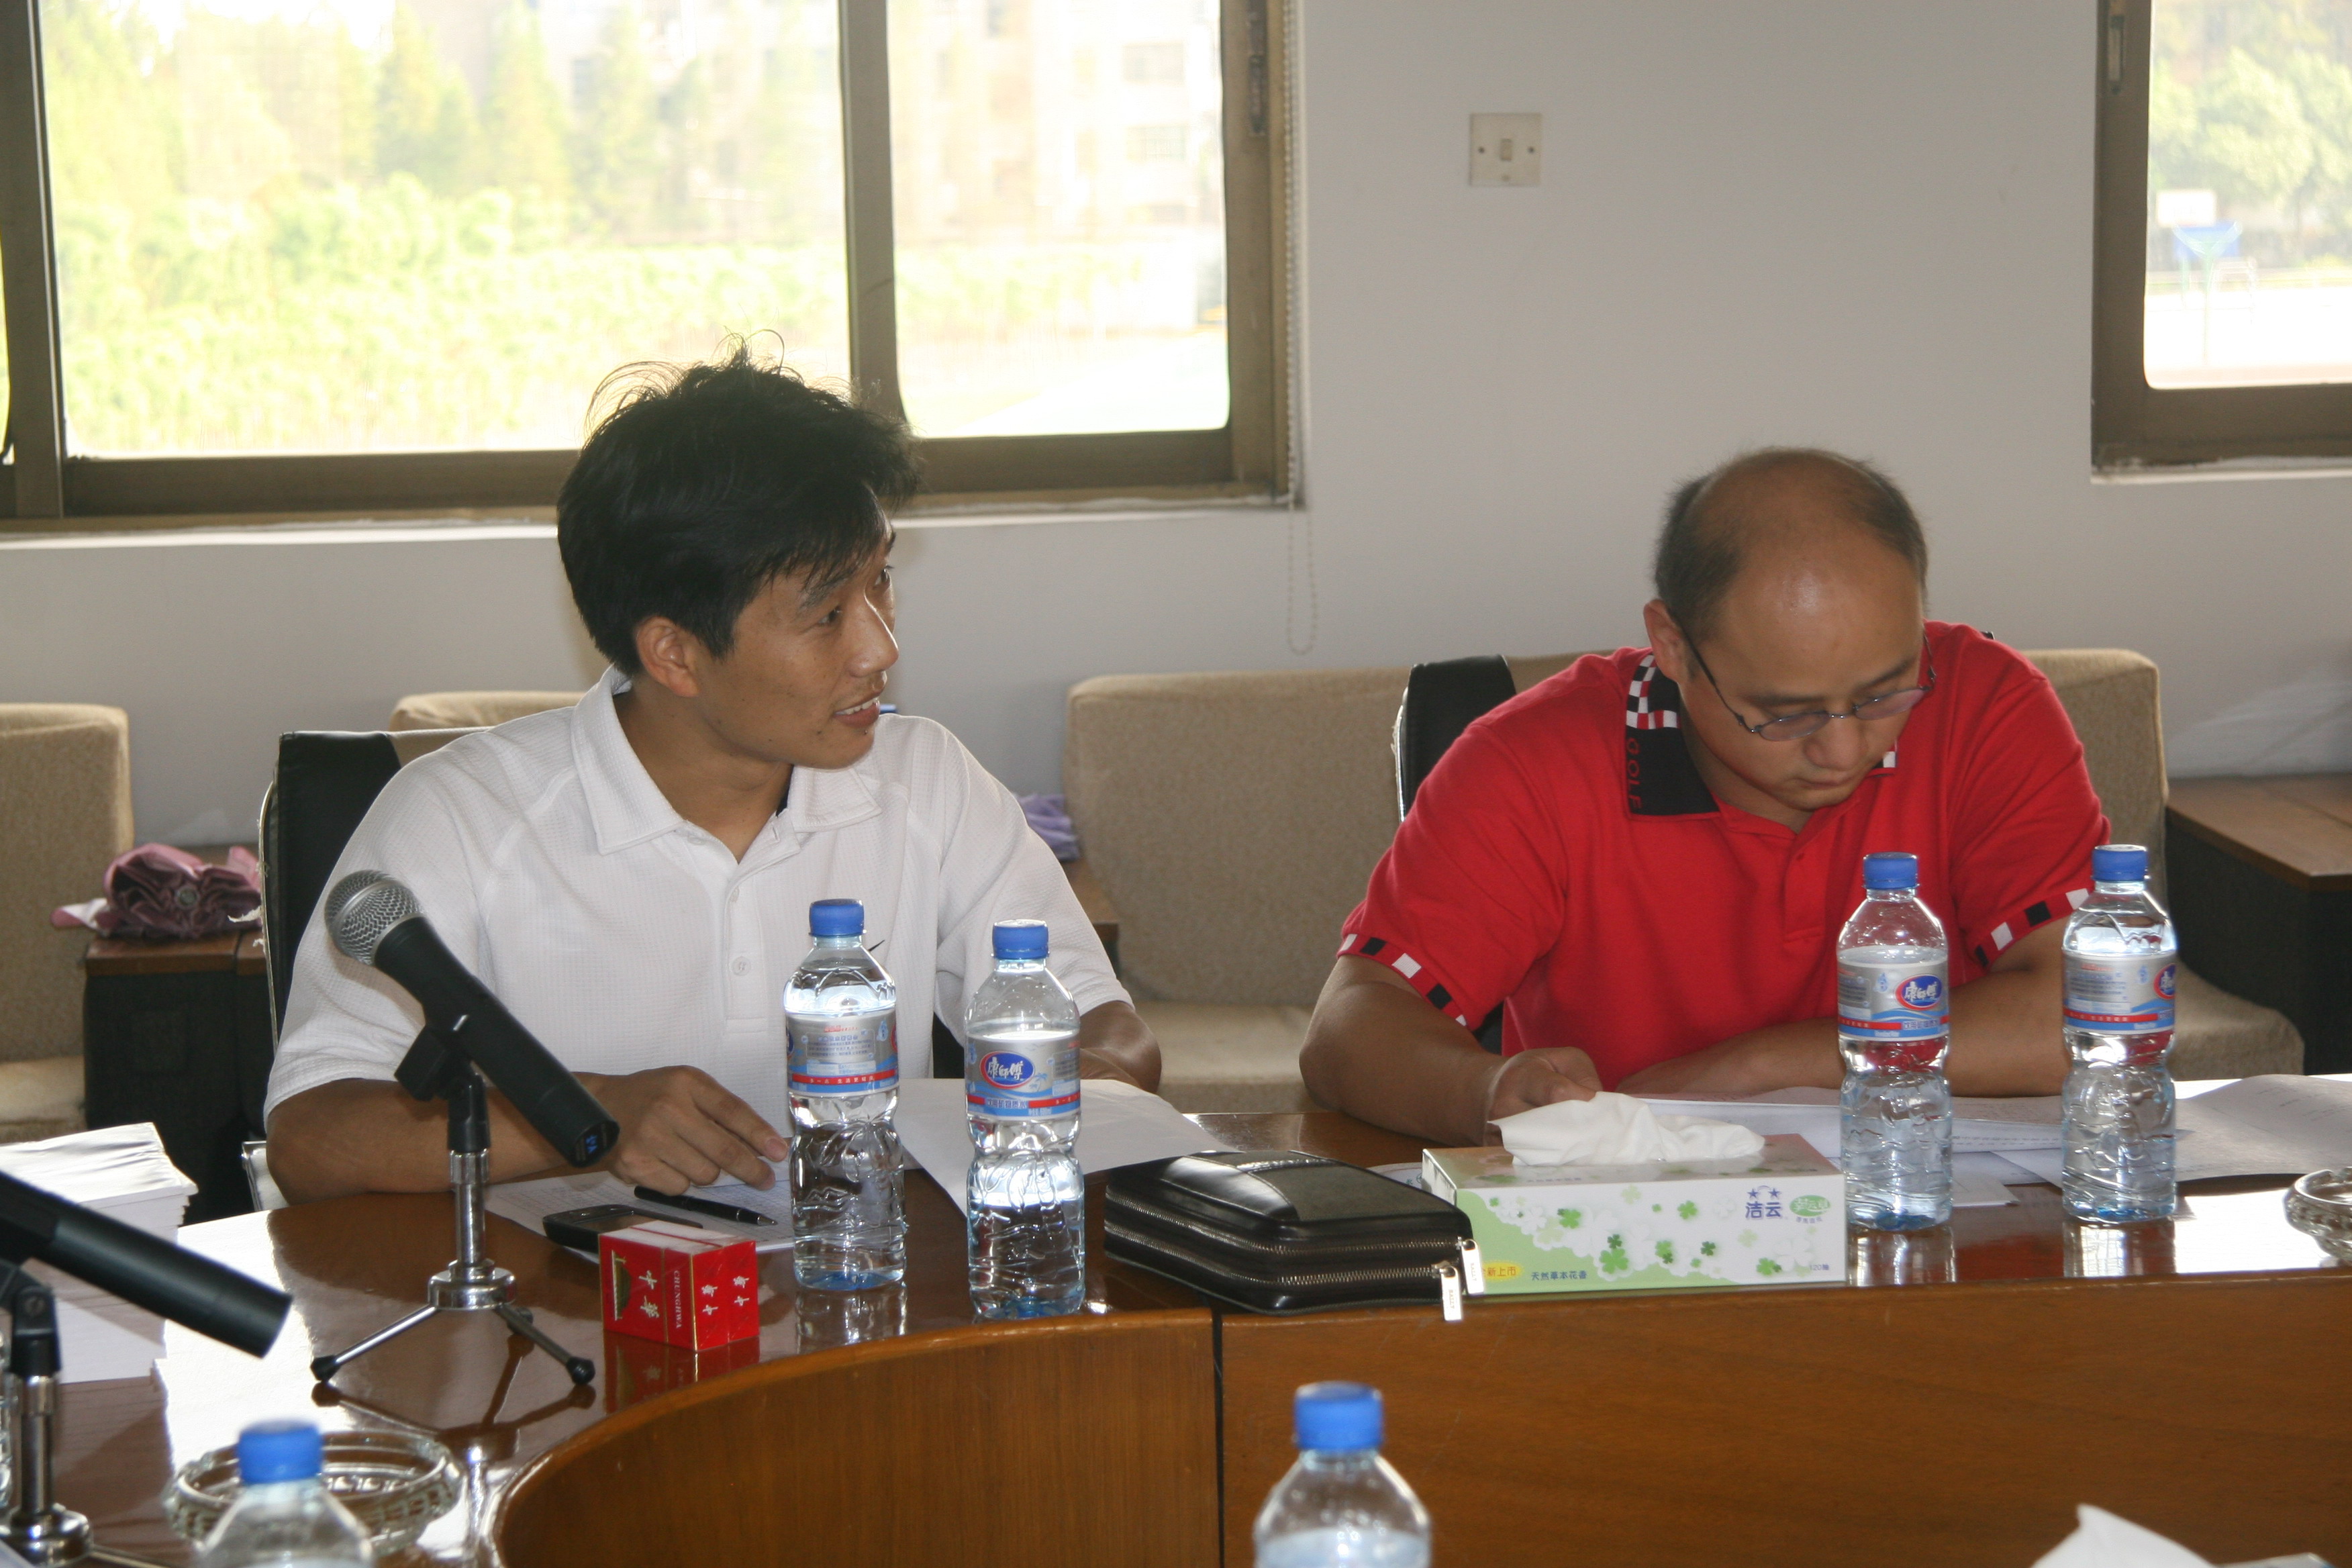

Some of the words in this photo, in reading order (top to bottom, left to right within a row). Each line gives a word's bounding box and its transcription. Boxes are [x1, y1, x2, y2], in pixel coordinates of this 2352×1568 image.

[1628, 738, 1642, 810] GOLF
[1745, 1201, 1781, 1219] 洁云
[1532, 1270, 1587, 1281] 天然草本花香
[673, 1270, 681, 1328] CHUNGHWA
